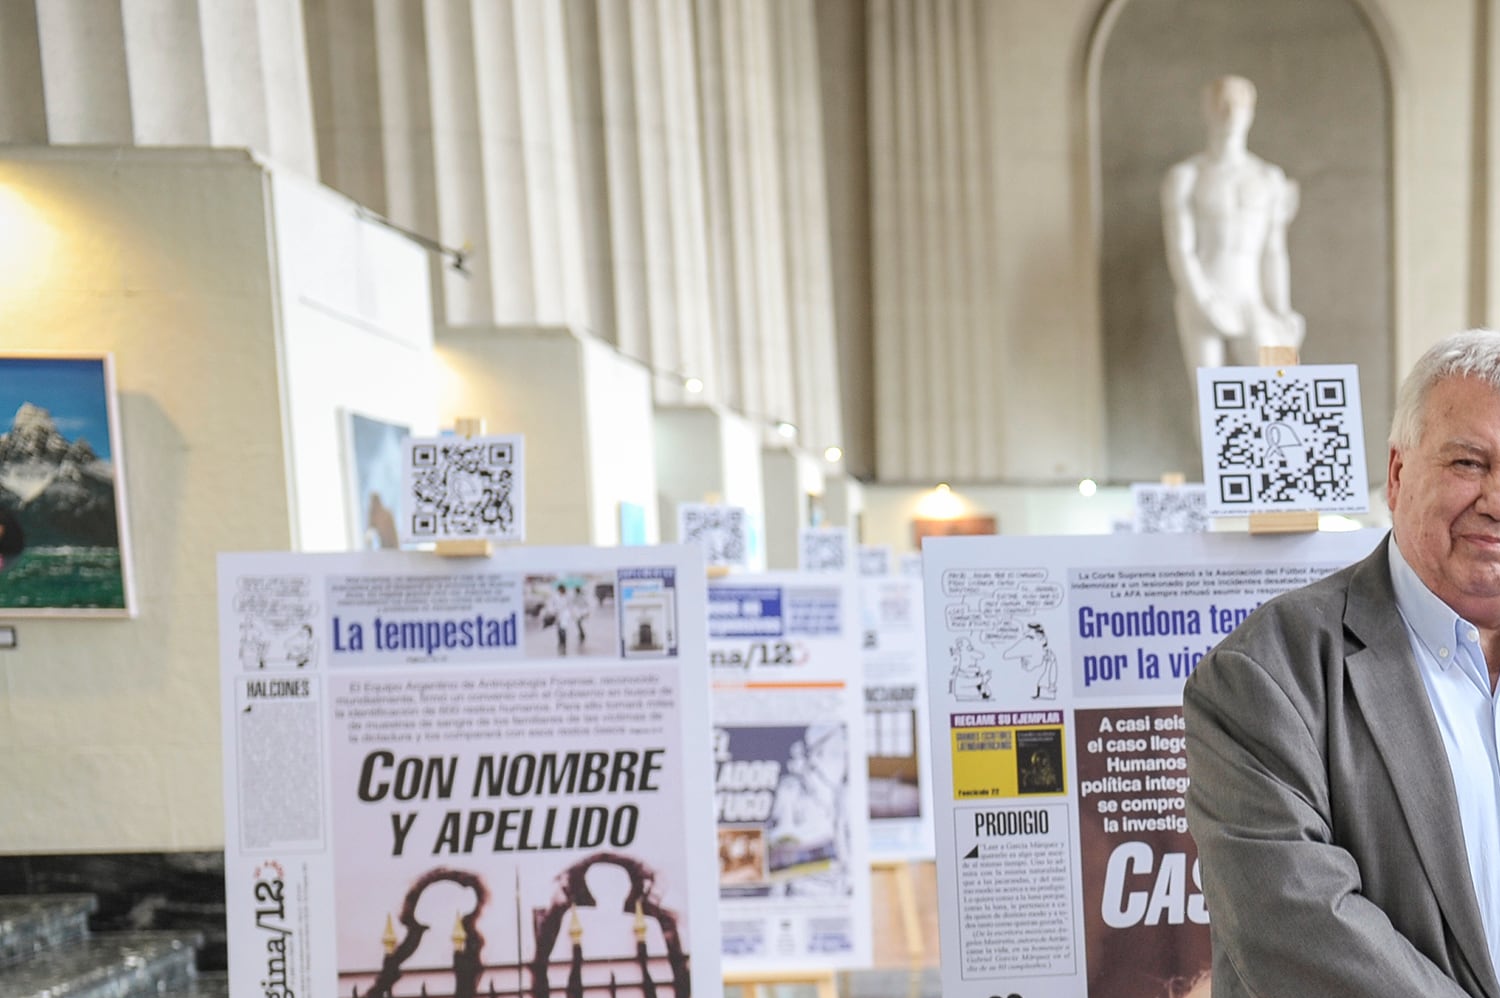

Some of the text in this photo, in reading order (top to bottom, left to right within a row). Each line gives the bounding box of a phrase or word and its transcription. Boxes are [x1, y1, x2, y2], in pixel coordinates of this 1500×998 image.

[1092, 571, 1115, 579] Corte
[1118, 571, 1156, 581] Suprema
[1142, 579, 1183, 588] lesionado
[1186, 580, 1200, 589] por
[1144, 589, 1178, 599] siempre
[1078, 602, 1202, 639] Grondona
[333, 611, 518, 655] La tempestad
[1084, 654, 1128, 687] por
[1137, 647, 1160, 680] la
[246, 680, 310, 698] HALCONES
[954, 711, 1060, 727] RECLAME SU EJEMPLAR
[1099, 716, 1113, 733] A
[1116, 715, 1151, 732] casi
[1087, 737, 1103, 753] el
[1106, 739, 1148, 753] caso
[472, 747, 666, 799] NOMBRE
[1107, 756, 1187, 773] Humanos
[1081, 775, 1142, 797] política
[1097, 799, 1118, 813] se
[391, 803, 640, 857] Y APELLIDO
[974, 809, 1049, 838] PRODIGIO
[1103, 817, 1119, 833] la
